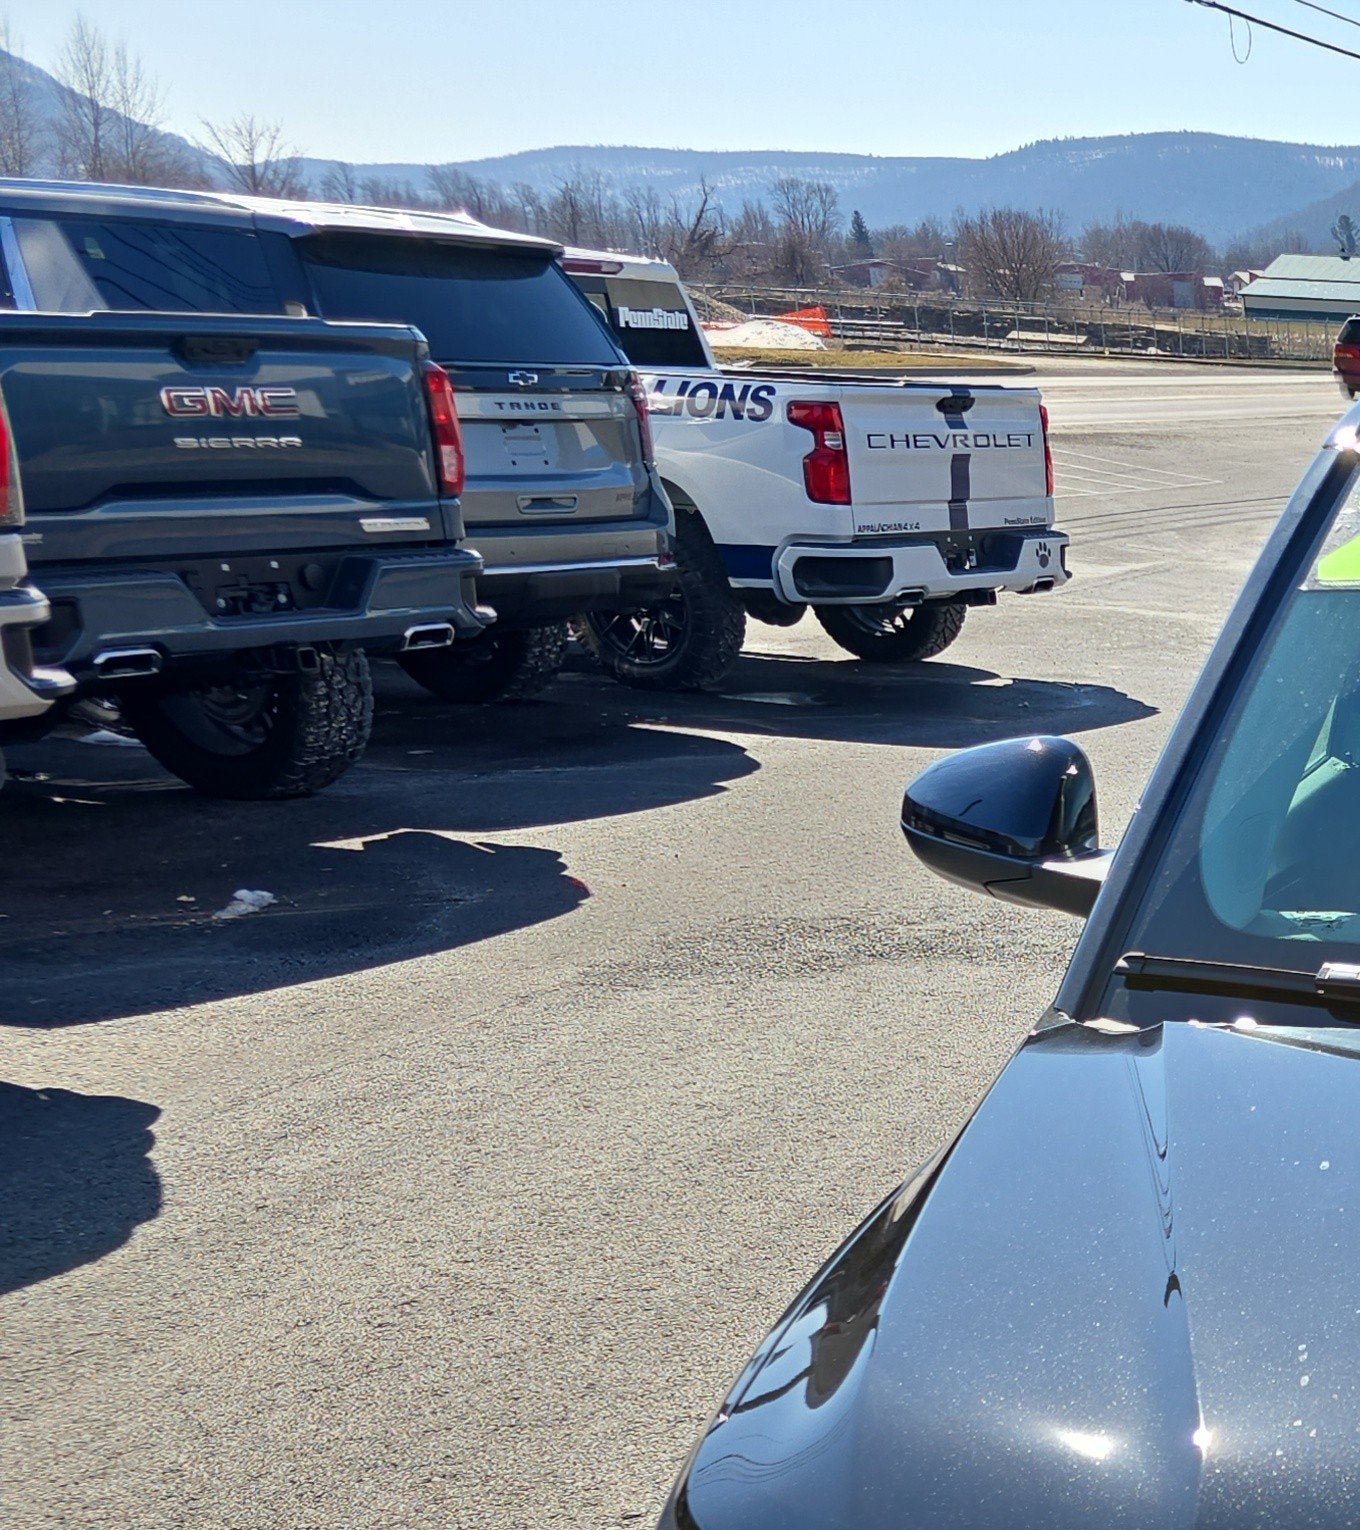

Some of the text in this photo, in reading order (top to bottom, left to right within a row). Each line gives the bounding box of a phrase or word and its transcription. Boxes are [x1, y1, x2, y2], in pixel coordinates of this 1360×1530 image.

[618, 306, 689, 331] PennState
[159, 386, 301, 418] GMC
[494, 401, 561, 411] TAHOE
[648, 378, 777, 423] LIONS
[173, 437, 303, 449] SIERRA
[866, 433, 1035, 449] CHEVROLET
